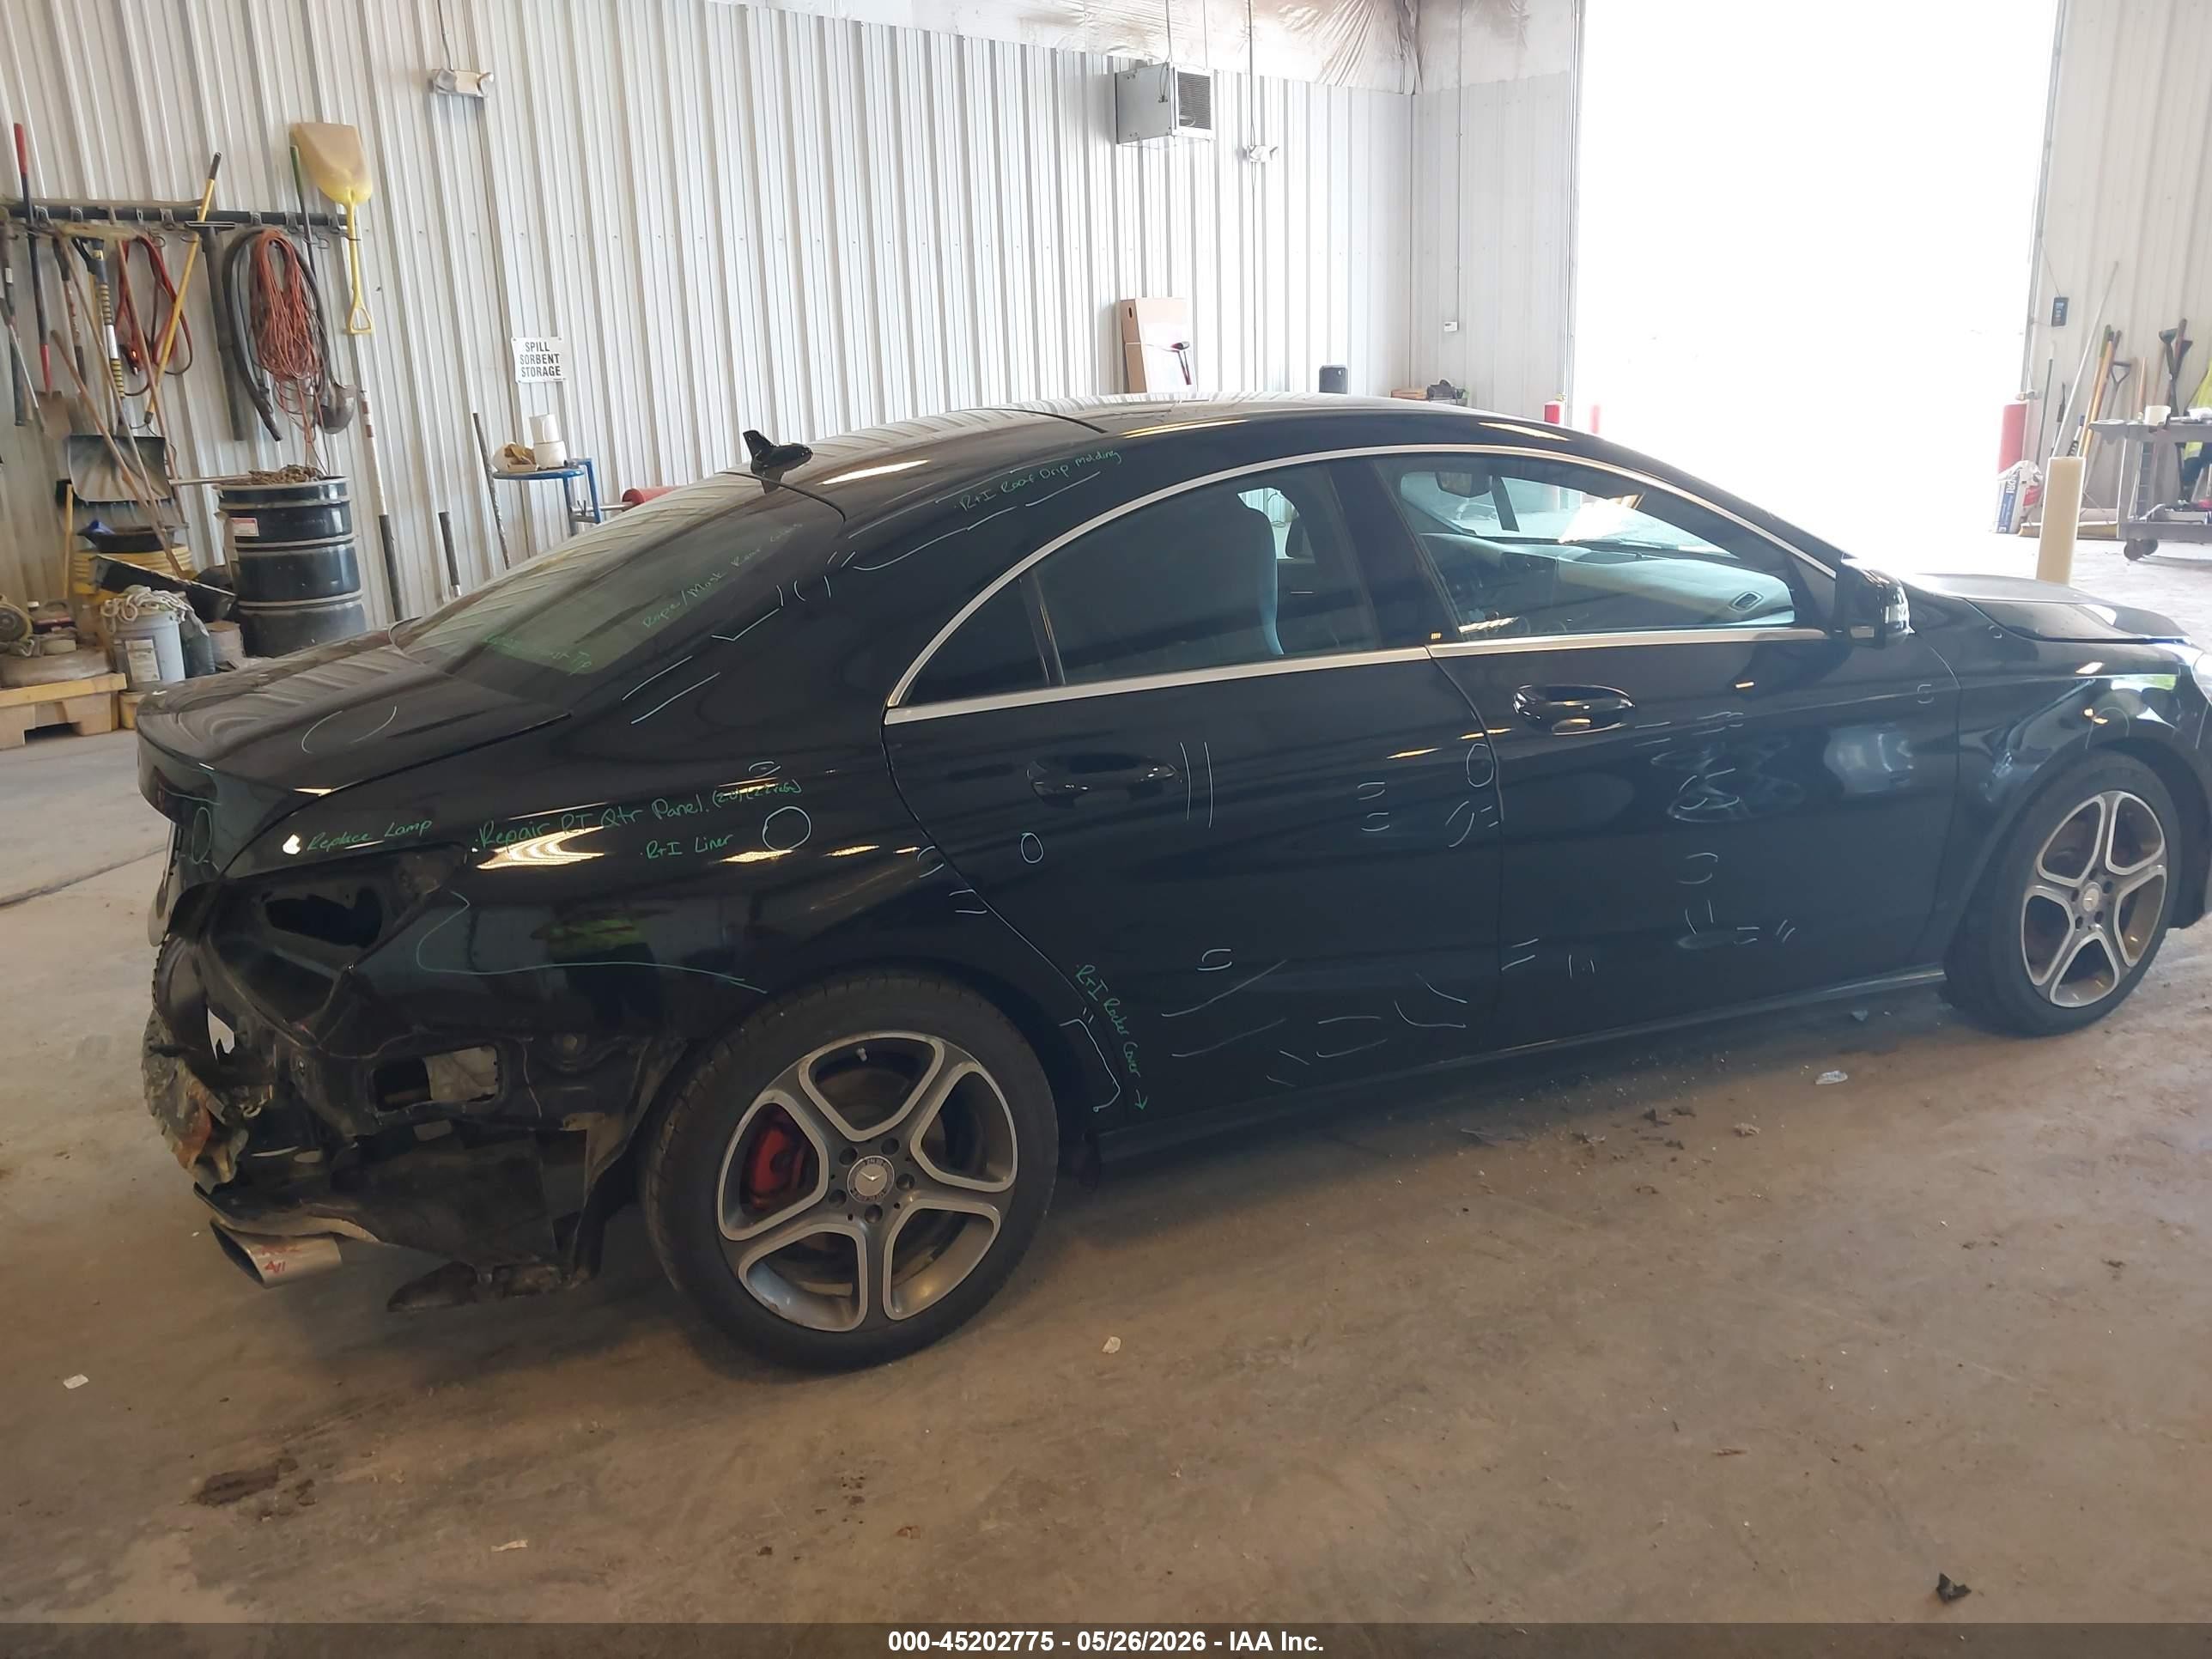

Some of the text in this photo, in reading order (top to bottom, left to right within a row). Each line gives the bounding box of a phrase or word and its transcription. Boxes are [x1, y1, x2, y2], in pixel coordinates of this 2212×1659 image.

[525, 341, 550, 352] SPILL
[519, 353, 560, 365] SORBENT
[520, 365, 562, 378] STORAGE
[384, 819, 433, 838] Lamp
[478, 820, 550, 854] Repair
[600, 805, 644, 830] Qtr
[694, 833, 734, 854] Liner
